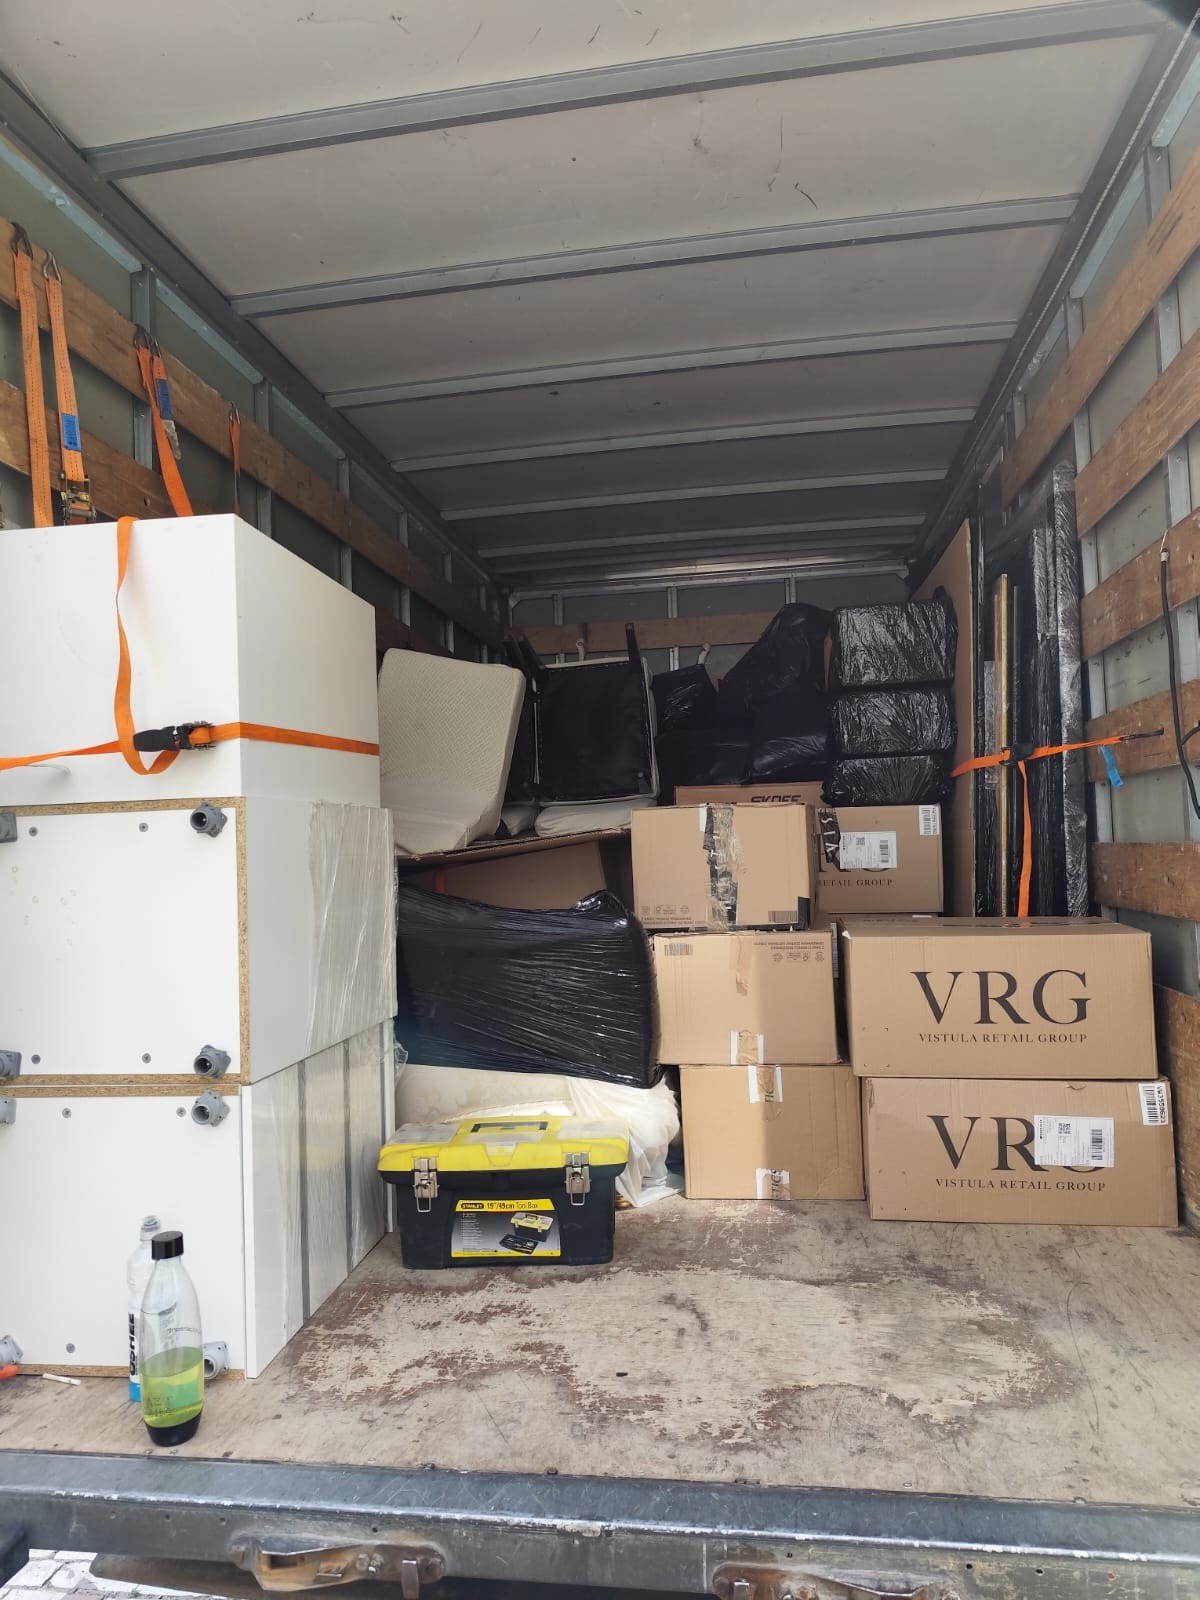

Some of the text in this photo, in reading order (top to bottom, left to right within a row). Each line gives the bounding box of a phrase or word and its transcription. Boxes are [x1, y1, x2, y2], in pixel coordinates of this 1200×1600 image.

[856, 879, 893, 888] GROUP
[910, 969, 1091, 1025] VRG
[919, 1033, 1088, 1043] VISTULA RETAIL GROUP
[927, 1115, 1105, 1172] VR
[935, 1178, 1106, 1192] VISTULA RETAIL GROUP
